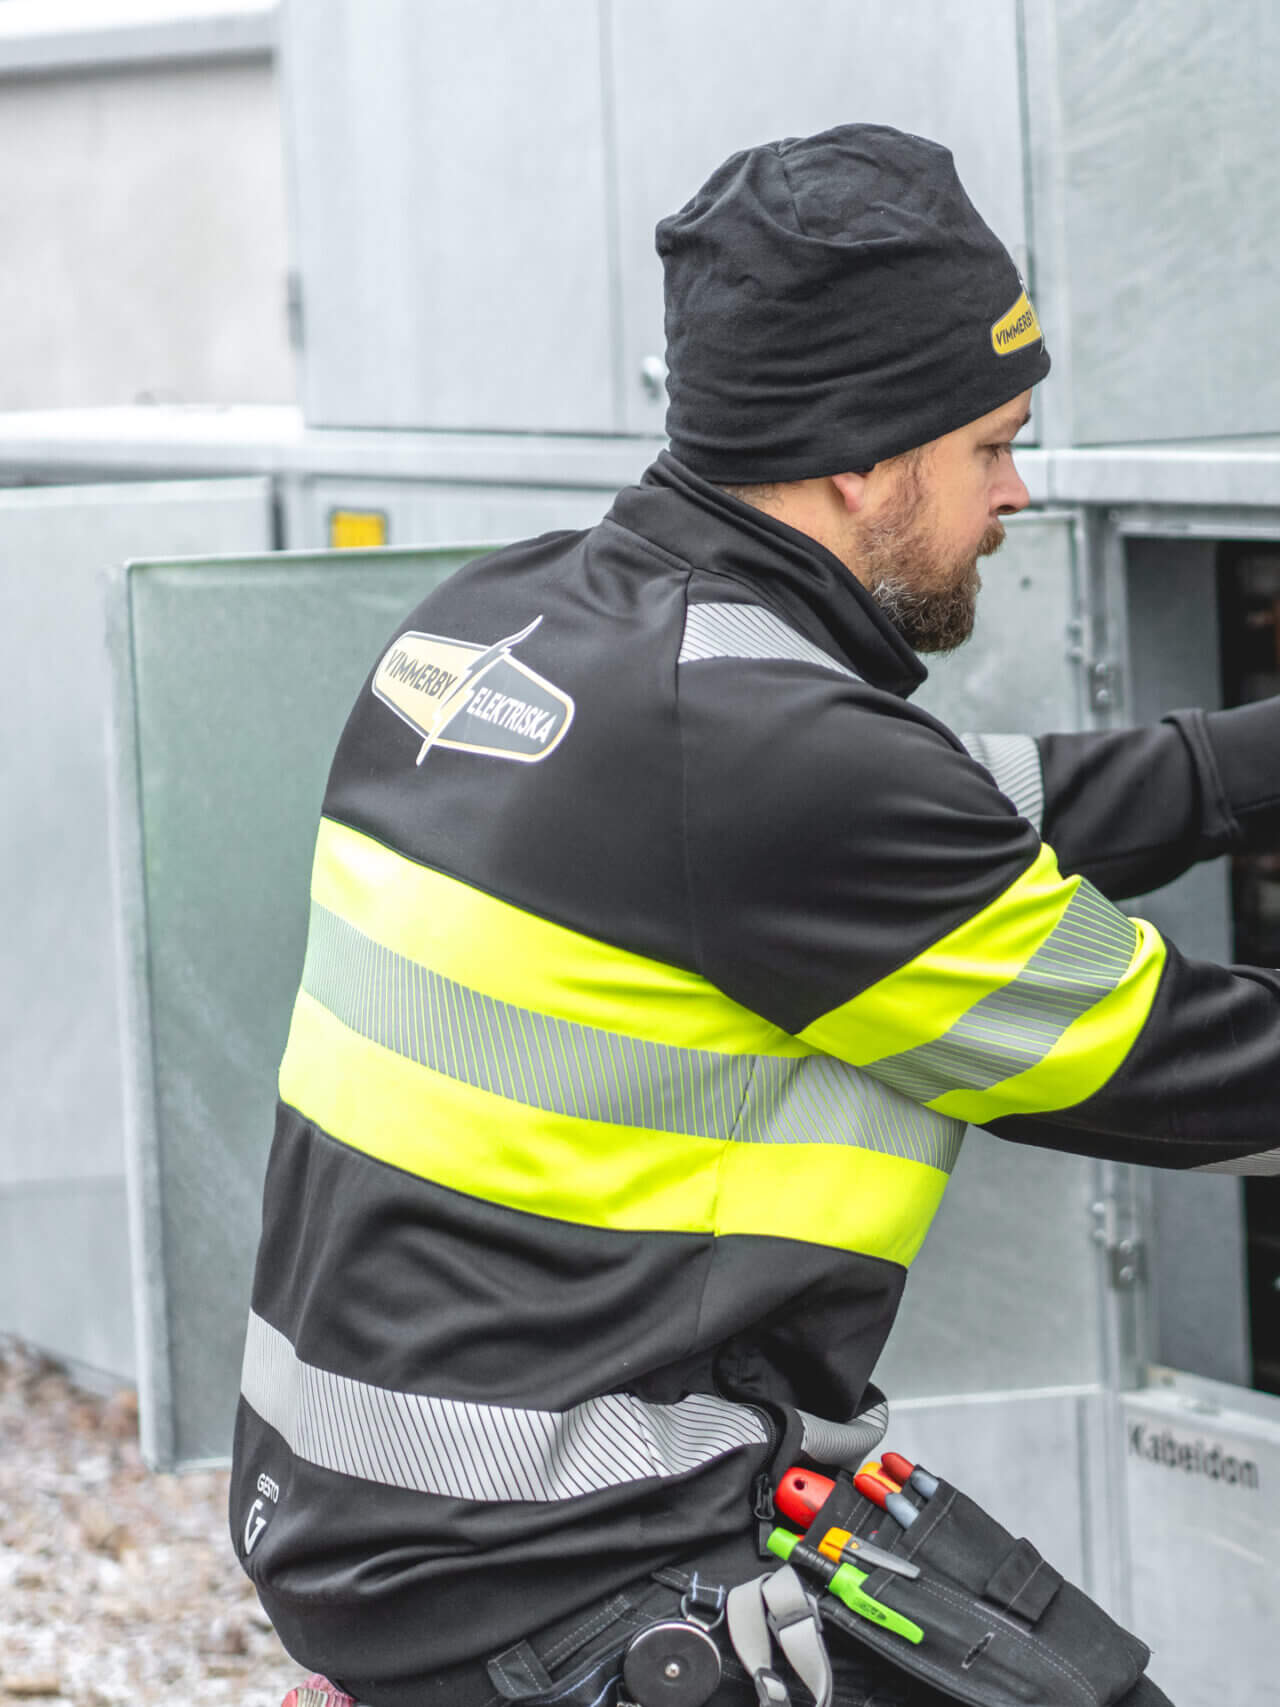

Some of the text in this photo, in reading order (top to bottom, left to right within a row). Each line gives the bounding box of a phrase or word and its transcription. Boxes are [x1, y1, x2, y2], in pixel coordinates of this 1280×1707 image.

[384, 649, 459, 701] VIMMERBY
[466, 688, 557, 744] ELEKTRISKA
[1128, 1424, 1260, 1490] Kabeldon
[256, 1472, 280, 1504] GESTO
